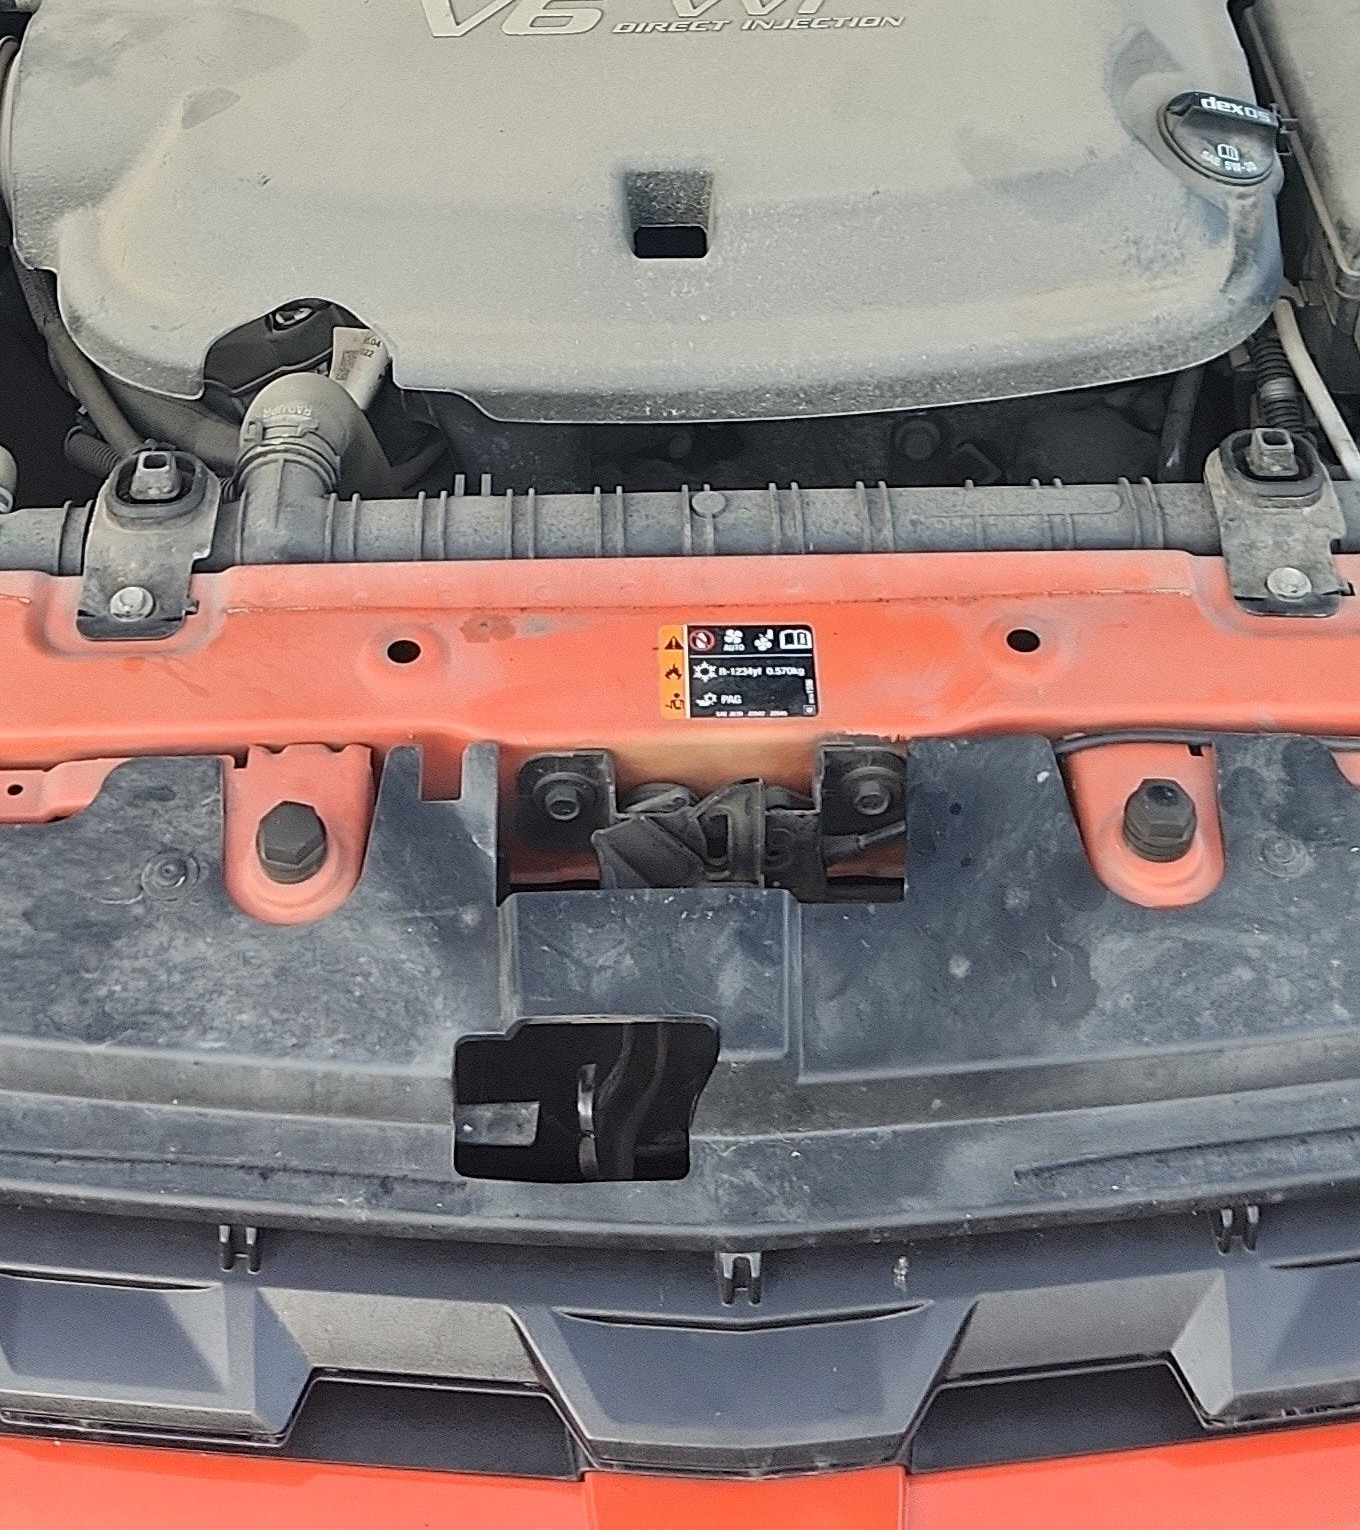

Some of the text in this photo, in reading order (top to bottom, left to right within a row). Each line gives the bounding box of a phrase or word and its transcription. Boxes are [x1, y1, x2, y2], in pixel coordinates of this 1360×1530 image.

[612, 15, 906, 35] DIRECT INJECTION
[1200, 96, 1271, 121] dexos
[723, 643, 745, 652] AUTO
[720, 694, 743, 705] PAG
